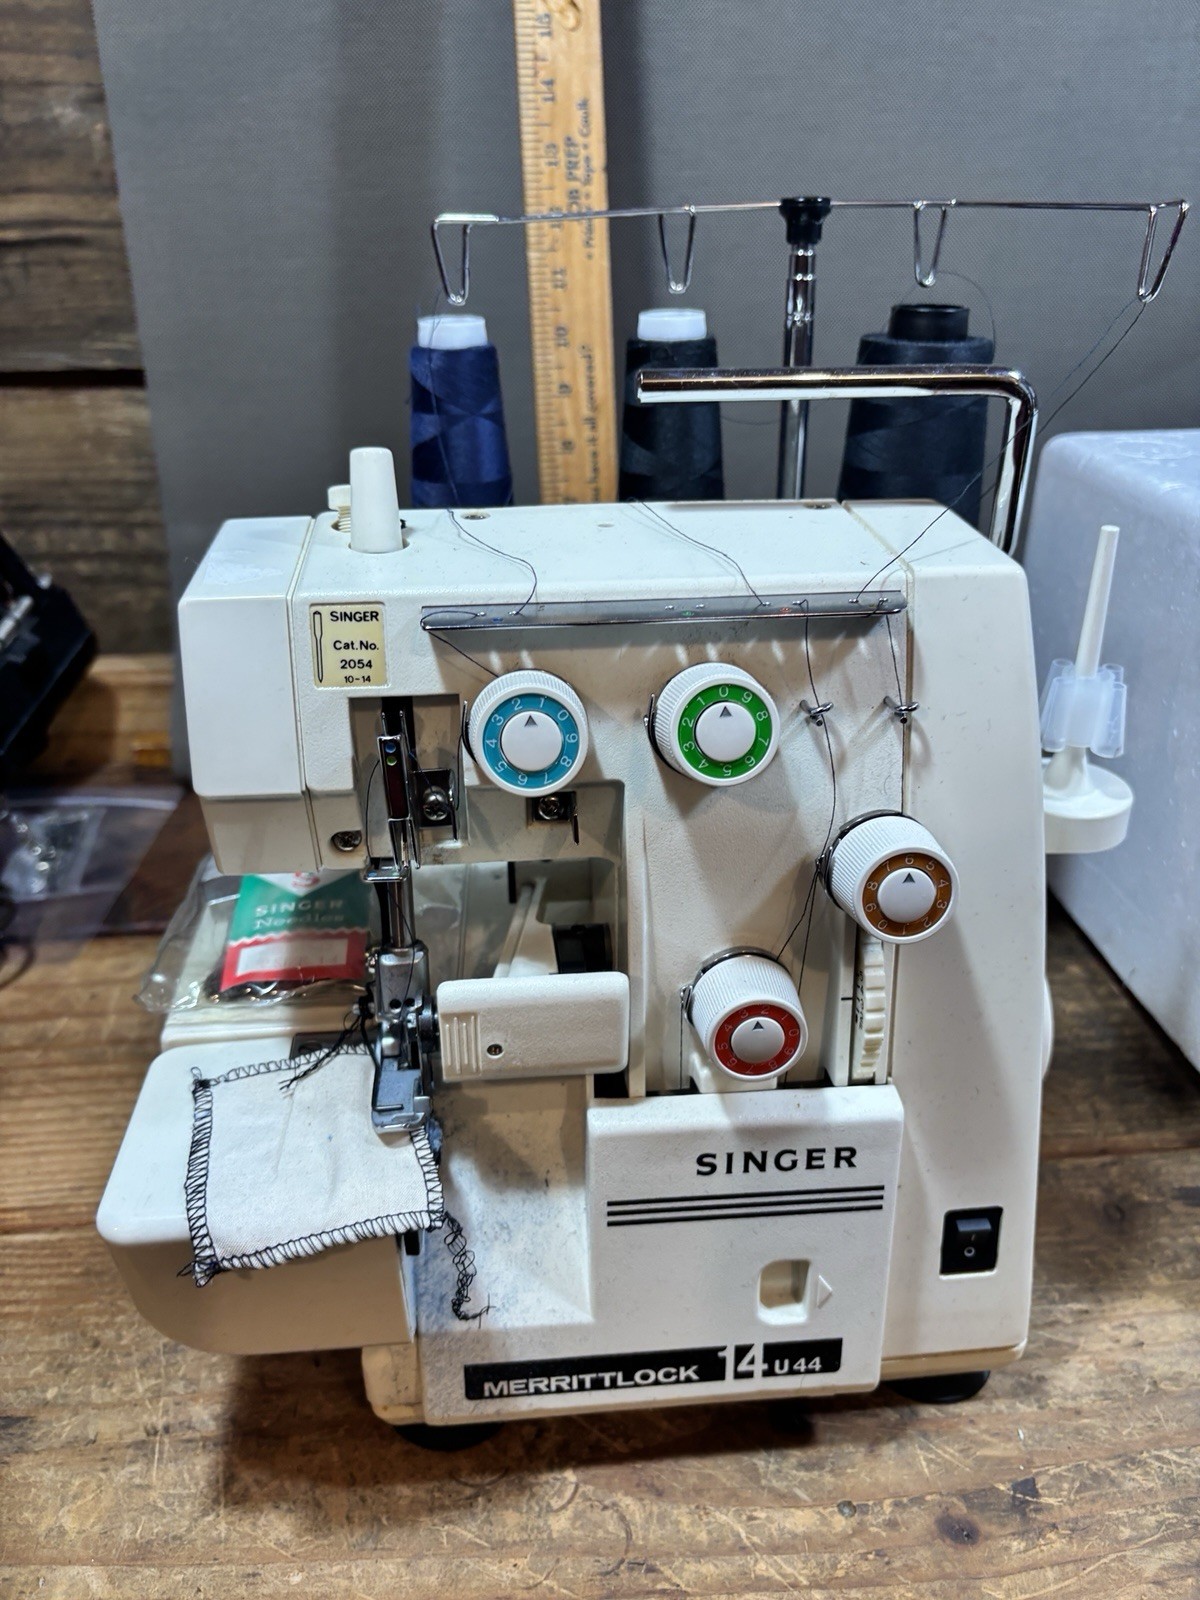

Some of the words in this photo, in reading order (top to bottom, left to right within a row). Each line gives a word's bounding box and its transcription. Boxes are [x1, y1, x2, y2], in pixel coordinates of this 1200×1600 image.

[541, 79, 555, 103] 14
[545, 142, 559, 168] 13
[564, 135, 579, 182] PREP
[556, 325, 569, 348] 10
[330, 610, 379, 622] SINGER
[340, 659, 372, 669] 2054
[344, 674, 371, 683] 10-14
[719, 686, 728, 697] 0
[741, 691, 753, 703] 9
[511, 698, 523, 710] 2
[540, 698, 545, 708] 1
[696, 697, 706, 706] 1
[492, 714, 504, 726] 3
[557, 709, 569, 721] 0
[756, 710, 769, 721] 8
[682, 717, 694, 728] 2
[486, 739, 498, 748] 4
[565, 733, 578, 743] 9
[758, 737, 769, 746] 7
[683, 741, 695, 752] 3
[560, 756, 572, 767] 8
[698, 759, 709, 769] 4
[745, 755, 756, 767] 6
[495, 761, 508, 773] 5
[722, 764, 732, 776] 5
[517, 773, 528, 785] 6
[544, 772, 552, 785] 7
[905, 855, 914, 865] 6
[926, 860, 937, 871] 5
[882, 861, 891, 872] 7
[866, 881, 878, 890] 8
[938, 879, 949, 888] 4
[254, 900, 344, 917] SINGER
[865, 902, 877, 912] 9
[936, 900, 947, 909] 3
[254, 911, 344, 930] Needles
[878, 920, 888, 930] 0
[921, 916, 932, 928] 2
[902, 925, 906, 935] 1
[696, 1146, 857, 1176] SINGER
[483, 1365, 700, 1398] MERRITTLOCK
[717, 1343, 769, 1380] 14
